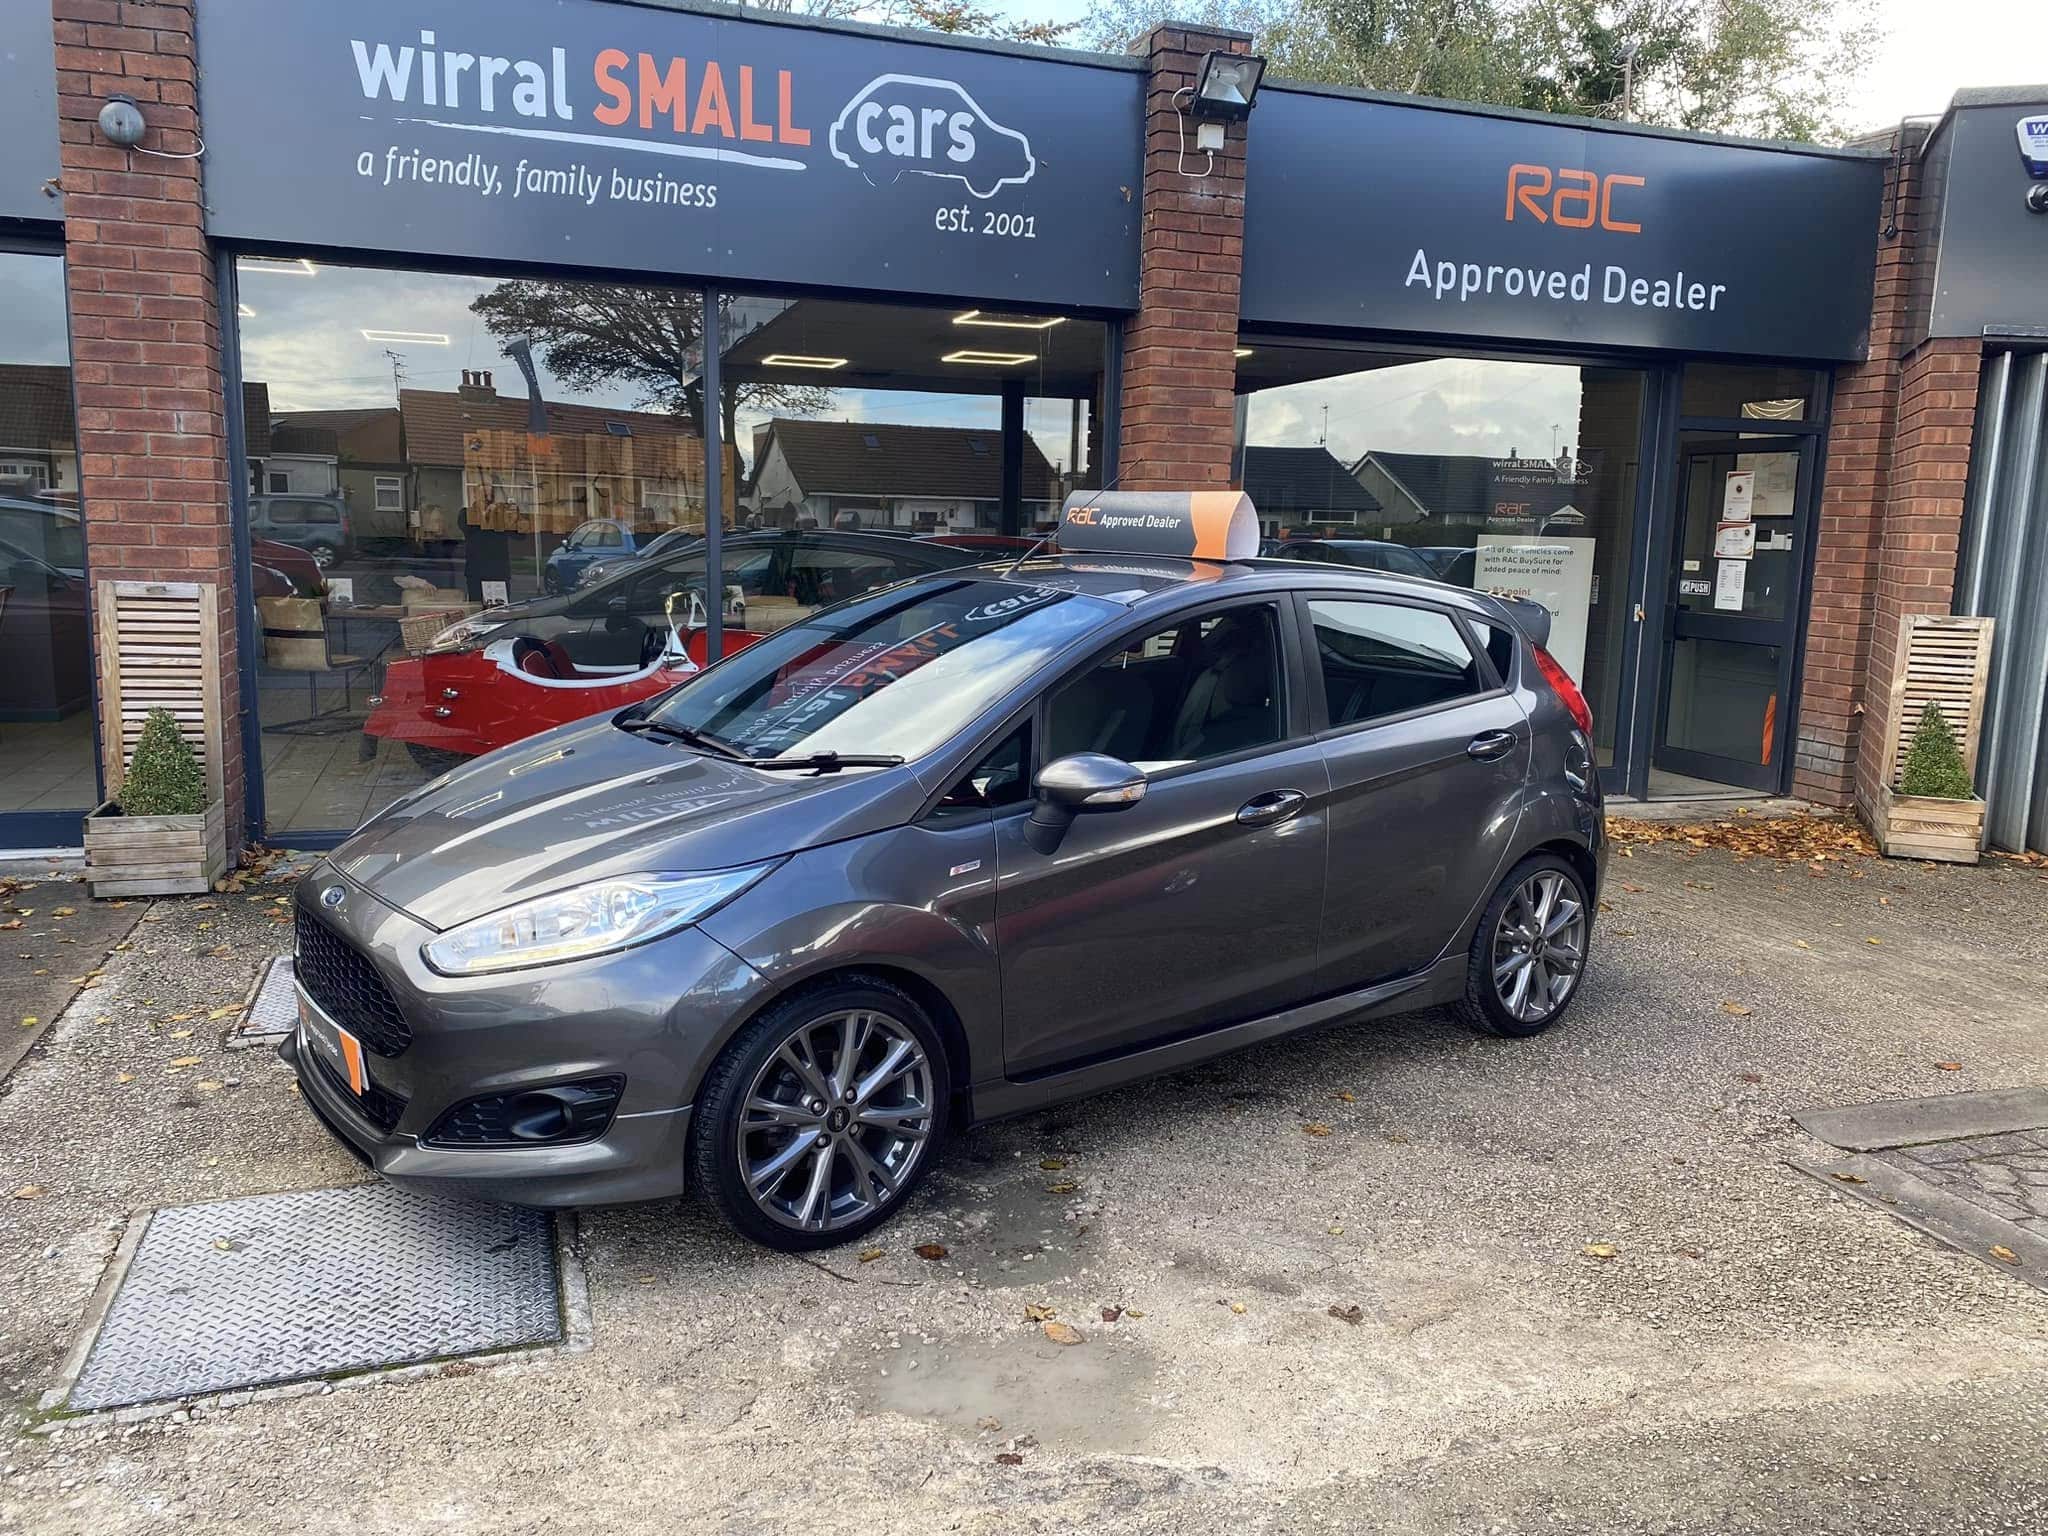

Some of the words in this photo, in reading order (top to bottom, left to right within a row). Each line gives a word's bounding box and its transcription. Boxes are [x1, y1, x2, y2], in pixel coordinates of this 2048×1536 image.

[351, 30, 573, 120] wirral
[593, 48, 811, 146] SMALL
[857, 101, 976, 162] cars
[357, 151, 374, 177] a
[384, 146, 502, 196] friendly,
[514, 159, 602, 205] family
[610, 168, 718, 208] business
[935, 204, 974, 232] est.
[983, 212, 1037, 238] 2001
[1405, 249, 1591, 302] Approved
[1603, 266, 1726, 311] Dealer
[1502, 475, 1531, 485] Friendly
[1532, 476, 1555, 486] Family
[1100, 514, 1145, 528] Approved
[1146, 515, 1180, 528] Dealer
[1520, 557, 1551, 566] BuySure
[1691, 582, 1709, 593] PUSH
